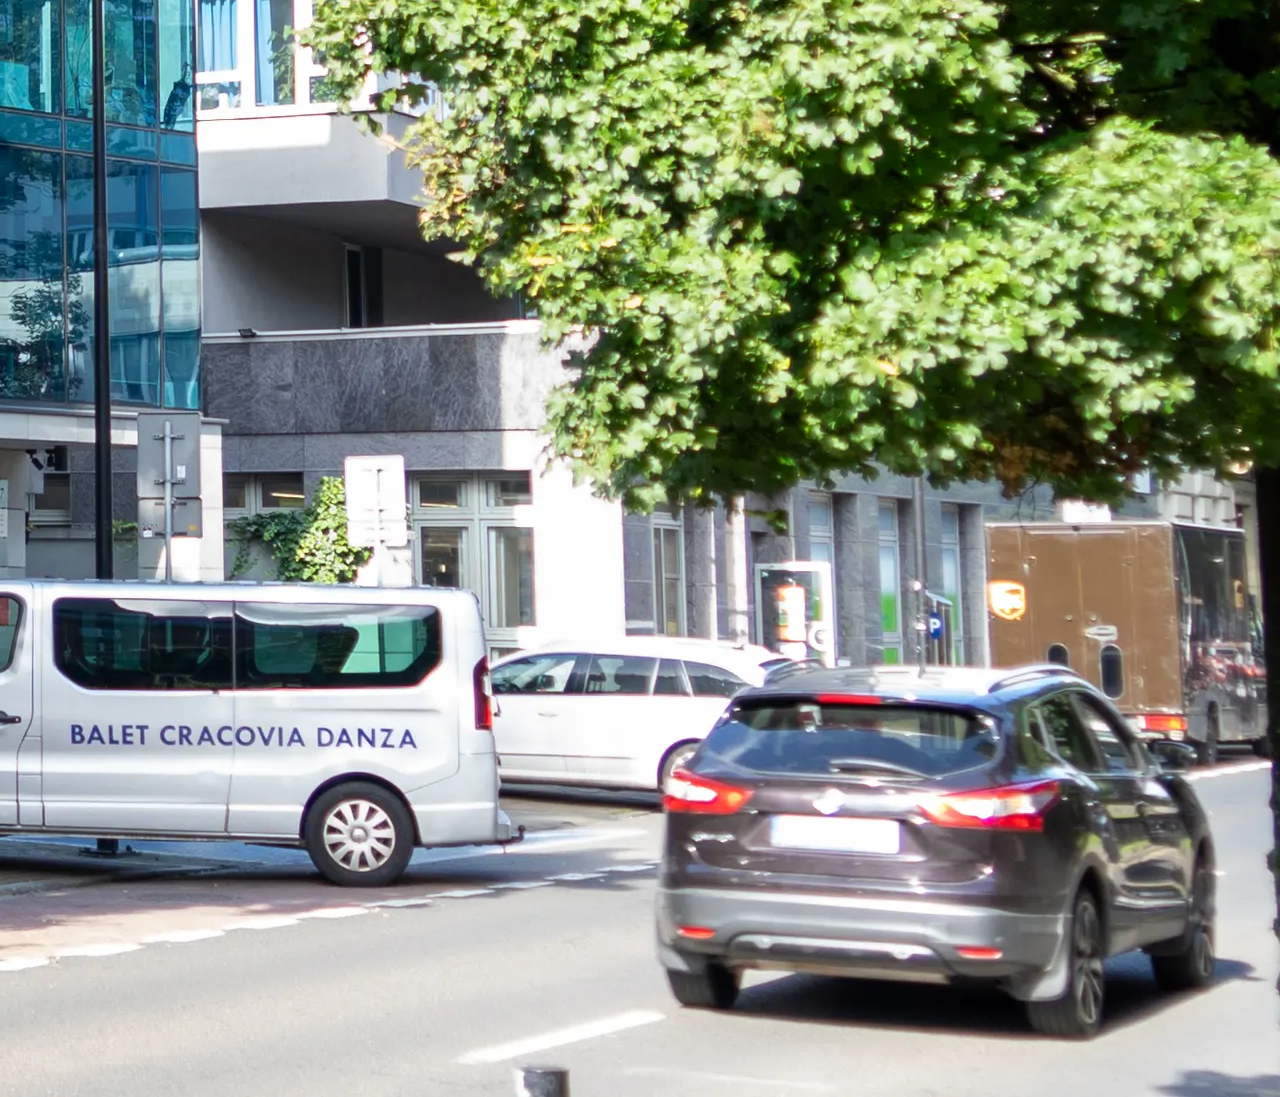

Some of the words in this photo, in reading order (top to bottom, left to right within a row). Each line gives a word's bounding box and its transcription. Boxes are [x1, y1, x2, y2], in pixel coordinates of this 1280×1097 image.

[70, 724, 149, 746] BALET
[160, 725, 306, 748] CRACOVIA
[316, 727, 418, 749] DANZA
